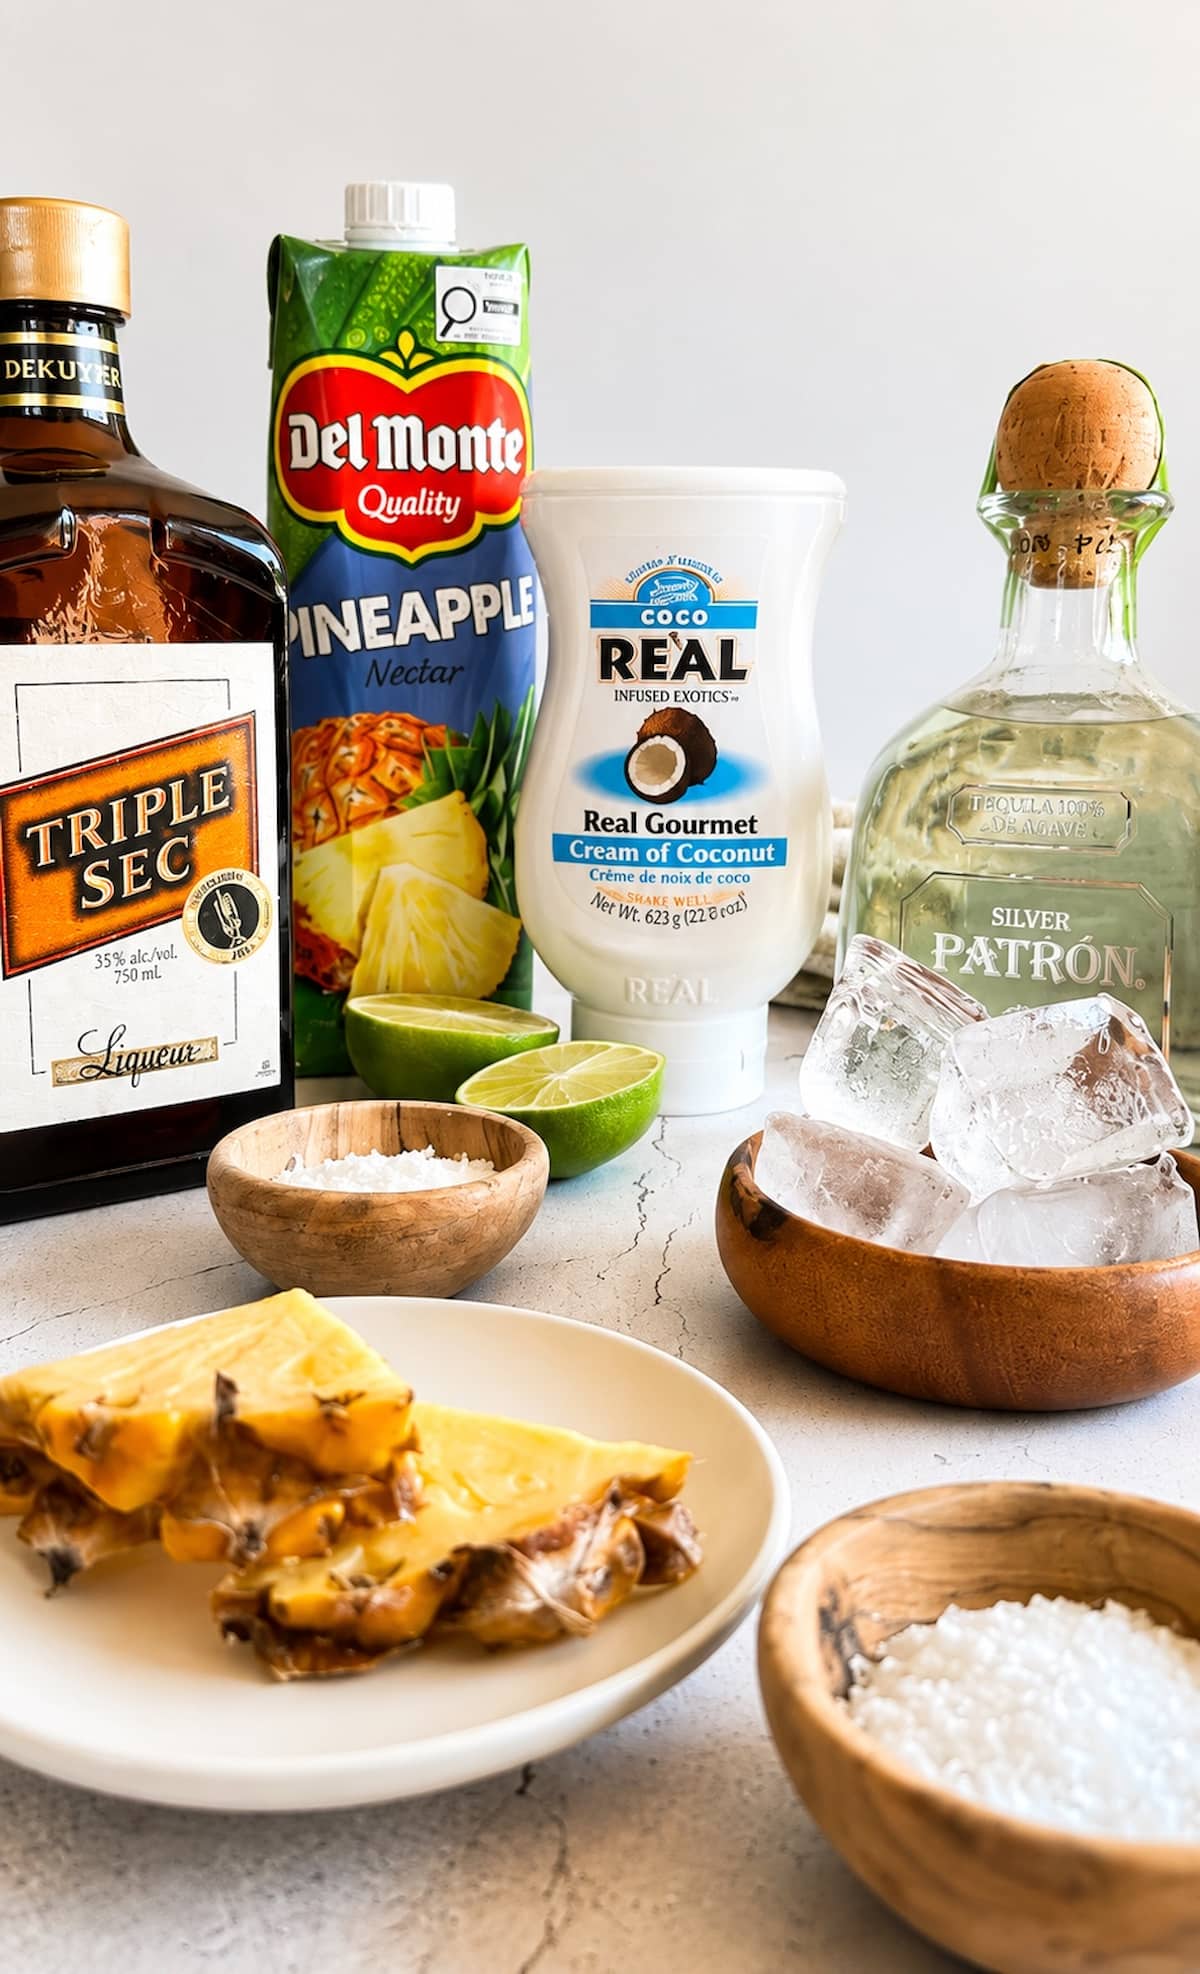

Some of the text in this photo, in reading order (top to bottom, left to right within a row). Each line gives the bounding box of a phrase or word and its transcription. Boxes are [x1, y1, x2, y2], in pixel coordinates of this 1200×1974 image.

[288, 412, 525, 475] Del Monte
[357, 483, 461, 524] Quality
[640, 608, 709, 626] COCO
[365, 657, 464, 688] Nectar
[614, 689, 670, 703] INFUSED
[674, 690, 729, 703] EXOTICS
[26, 766, 230, 868] TRIPLE
[969, 793, 1105, 818] TEQUILA 100%
[583, 809, 758, 836] Real Gourmet
[1022, 818, 1088, 839] AGAVE
[569, 838, 775, 864] Cream of Coconut
[81, 834, 190, 909] SEC
[639, 870, 656, 884] de
[660, 871, 692, 885] noix
[695, 871, 713, 884] de
[717, 873, 750, 884] coco
[590, 891, 616, 915] Net
[618, 905, 641, 923] Wt.
[645, 909, 670, 926] 623
[672, 913, 681, 930] g
[626, 892, 712, 907] SHAKE WELL
[991, 906, 1071, 932] SILVER
[94, 943, 178, 969] 35% alc./vol.
[114, 966, 138, 984] 750
[77, 1023, 201, 1088] Liqueur
